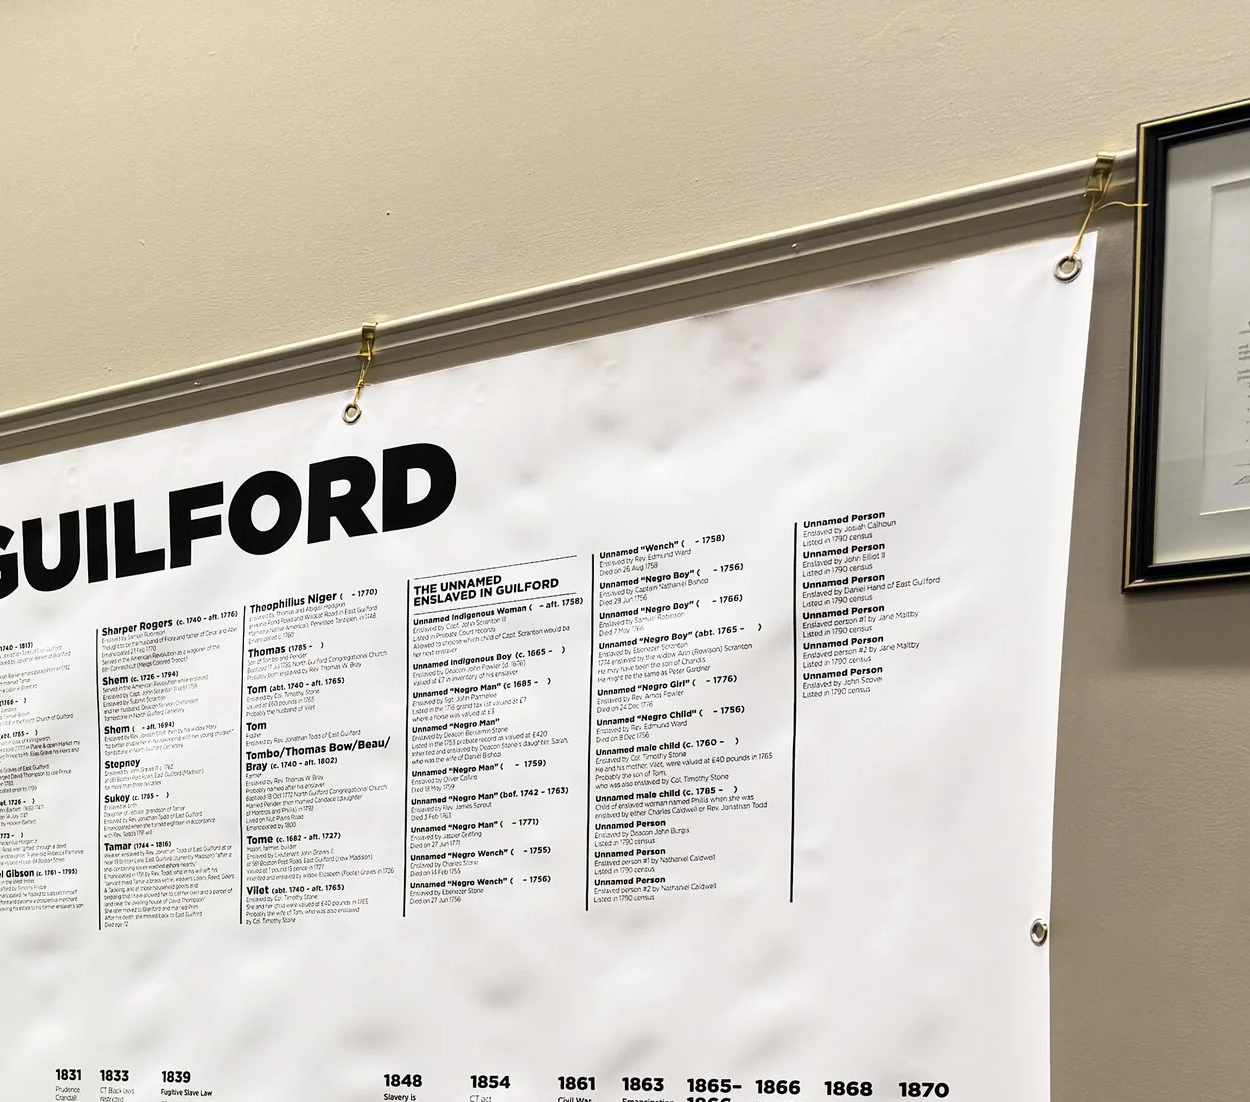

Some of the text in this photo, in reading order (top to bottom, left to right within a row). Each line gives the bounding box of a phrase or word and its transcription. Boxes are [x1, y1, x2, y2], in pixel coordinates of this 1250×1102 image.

[851, 512, 885, 523] Person
[851, 543, 885, 553] Person
[414, 575, 502, 596] THE UNNAMED
[851, 574, 885, 584] Person
[413, 575, 559, 607] ENSLAVED IN GUILFORD
[308, 593, 337, 604] Niger
[101, 619, 173, 638] Sharper Rogers
[246, 722, 267, 731] Tom
[245, 736, 390, 761] Tombo/Thomas Bow/Beau/
[246, 762, 268, 772] Bray
[104, 843, 132, 851] Tamar
[6, 869, 34, 878] Gibson
[55, 1069, 81, 1081] 1831
[100, 1069, 129, 1082] 1833
[162, 1071, 191, 1083] 1839
[384, 1074, 422, 1087] 1848
[470, 1075, 511, 1089] 1854
[558, 1076, 595, 1090] 1861
[622, 1077, 664, 1092] 1863
[755, 1079, 800, 1095] 1866
[824, 1081, 873, 1096] 1868
[899, 1082, 949, 1098] 1870
[384, 1093, 409, 1102] Slavery
